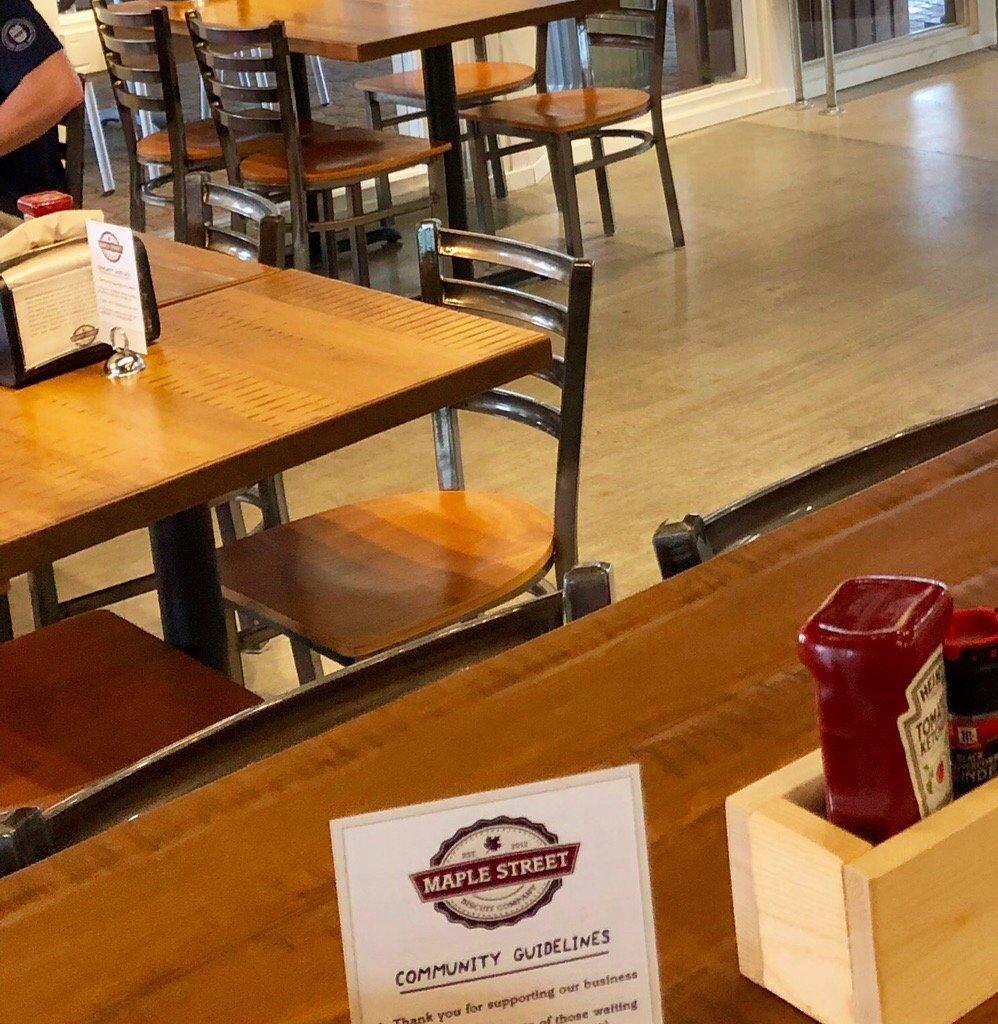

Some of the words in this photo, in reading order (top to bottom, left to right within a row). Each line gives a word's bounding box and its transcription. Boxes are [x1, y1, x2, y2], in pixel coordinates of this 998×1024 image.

[422, 866, 491, 894] MAPLE
[496, 850, 570, 880] STREET
[461, 897, 495, 912] BISCUIT
[497, 884, 536, 911] COMPANY
[395, 951, 502, 987] COMMUNITY
[513, 929, 611, 962] GUIDELINES
[437, 1008, 462, 1023] you
[465, 1003, 484, 1014] for
[487, 987, 555, 1010] supporting
[559, 983, 580, 995] our
[583, 971, 638, 989] business
[555, 1011, 589, 1023] those
[593, 1000, 638, 1017] waiting
